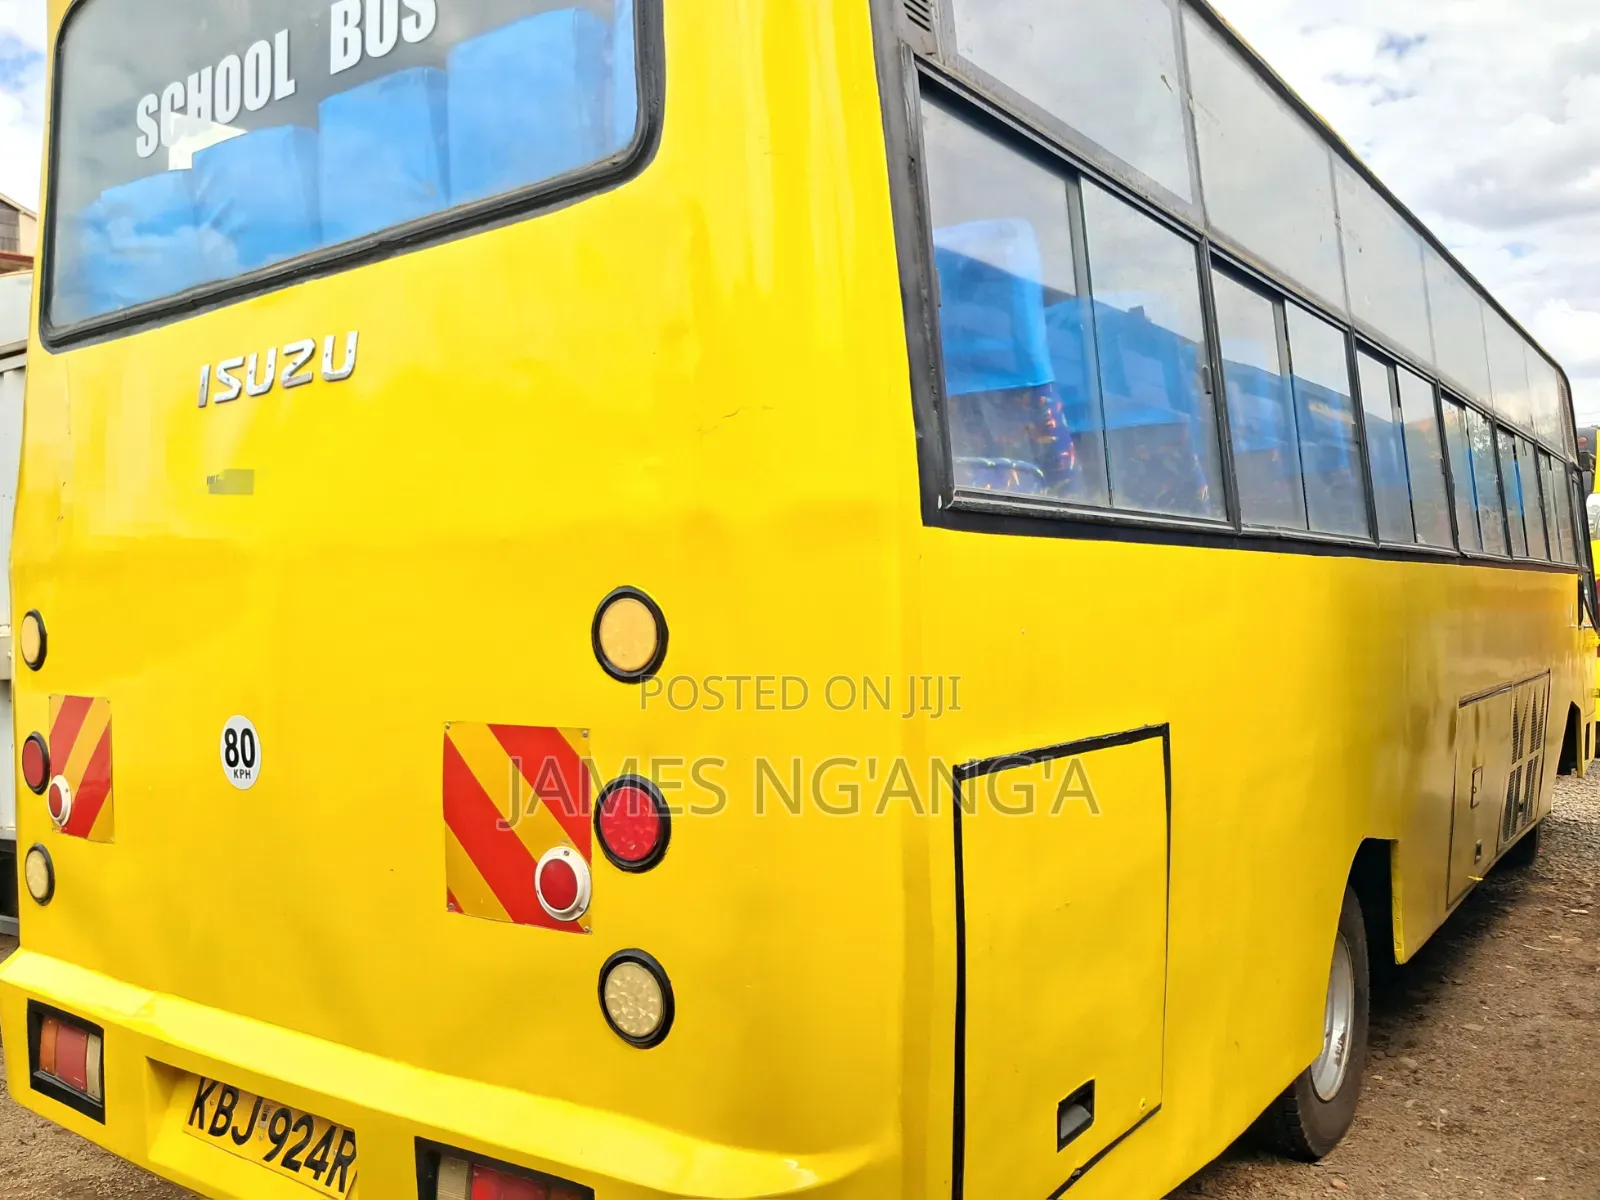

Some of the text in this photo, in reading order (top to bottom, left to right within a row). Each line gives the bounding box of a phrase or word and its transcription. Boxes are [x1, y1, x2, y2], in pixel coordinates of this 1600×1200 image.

[136, 0, 437, 158] SCHOOL BUS
[197, 330, 359, 408] ISUZU
[225, 728, 256, 768] 80
[233, 769, 252, 780] KPH
[188, 1077, 357, 1193] KBJ 924R
